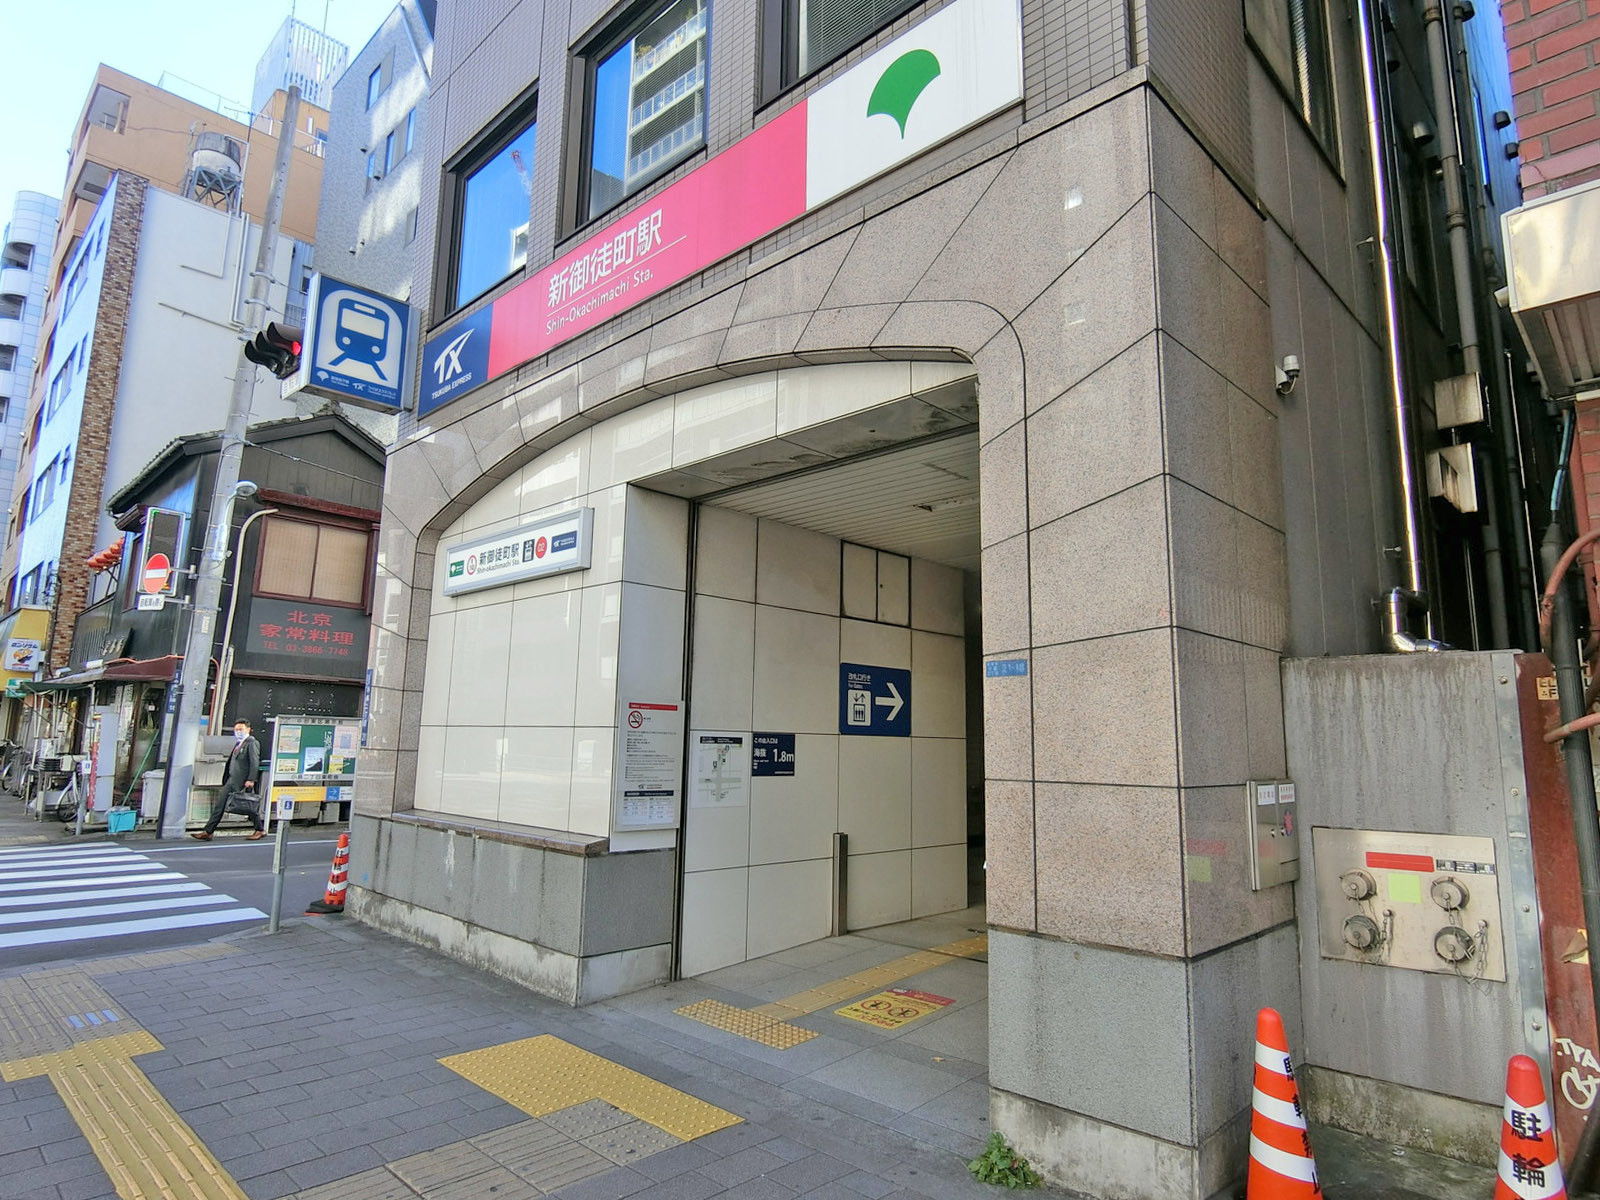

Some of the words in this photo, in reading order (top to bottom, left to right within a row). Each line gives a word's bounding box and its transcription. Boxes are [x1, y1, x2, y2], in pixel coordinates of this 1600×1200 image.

[547, 208, 662, 308] 新御徒町駅
[546, 276, 630, 336] Shin-Okachimachi
[633, 268, 654, 288] Sta.
[434, 328, 475, 384] TX
[431, 384, 452, 400] TSUKUBA
[451, 372, 473, 390] EXPRESS
[479, 543, 520, 566] 新御徒町駅
[286, 610, 334, 627] 北京
[259, 623, 355, 646] 家常料理
[263, 640, 278, 650] TEL
[848, 672, 872, 682] 改札口行き
[754, 748, 767, 758] 海抜
[772, 748, 795, 763] 1.8m
[1511, 1109, 1546, 1200] 駐輪
